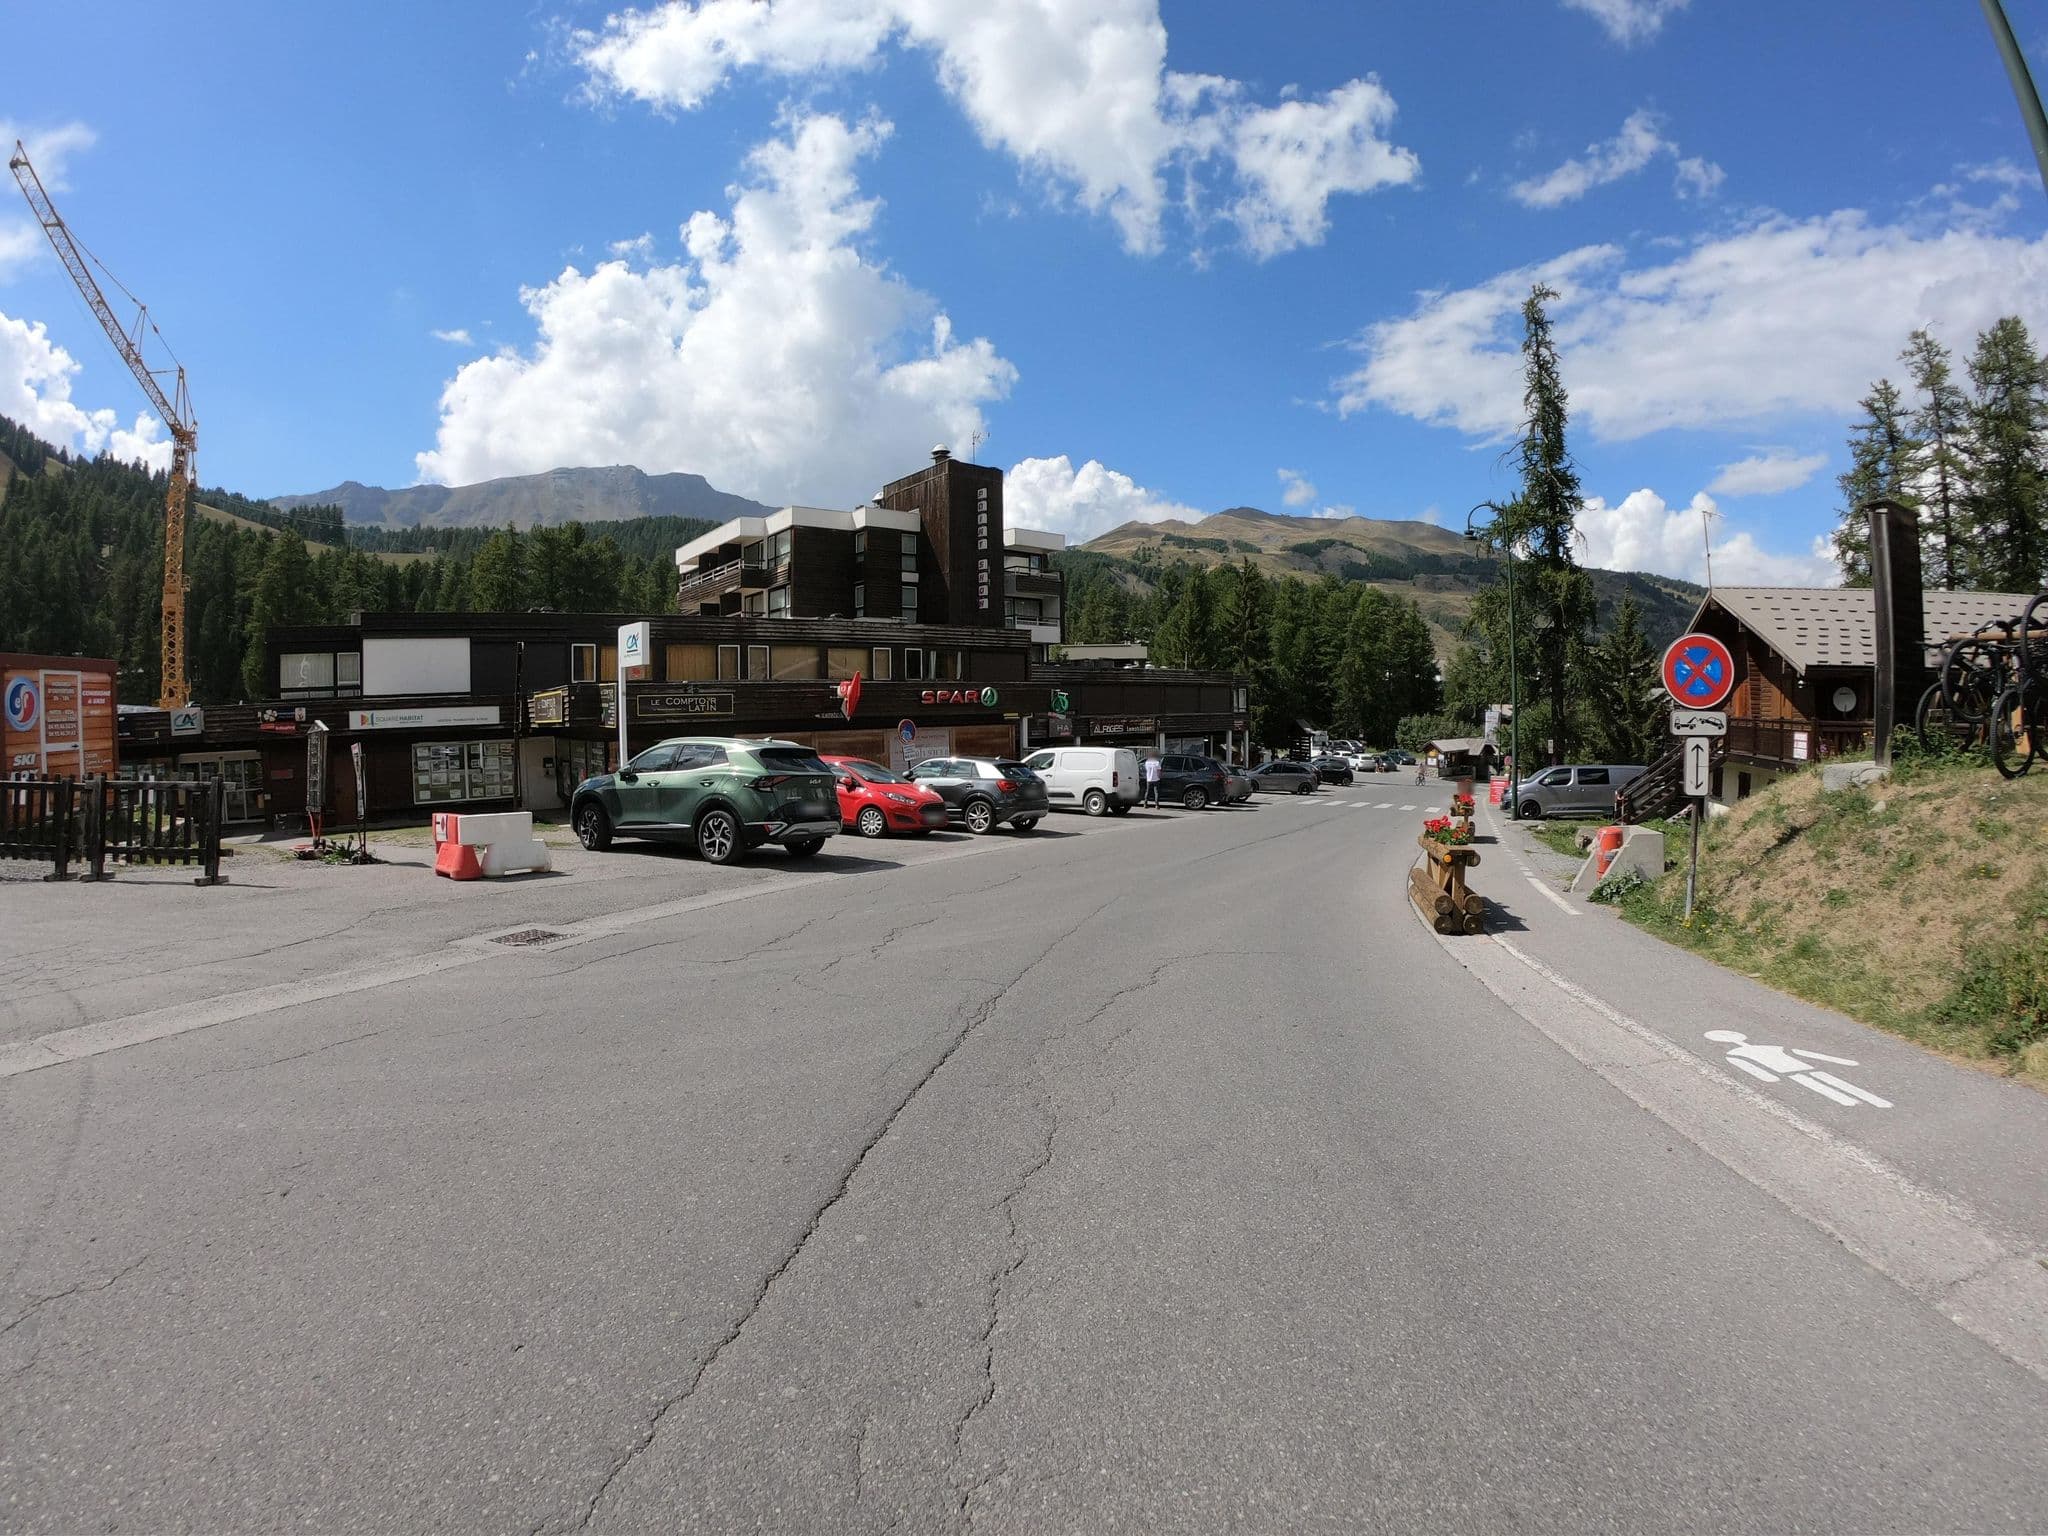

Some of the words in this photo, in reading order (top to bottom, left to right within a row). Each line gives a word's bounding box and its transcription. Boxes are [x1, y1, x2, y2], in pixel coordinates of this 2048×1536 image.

[665, 697, 717, 706] COMPTOIR
[921, 690, 980, 704] SPAR
[688, 703, 717, 712] LATIN
[13, 753, 36, 767] SKI
